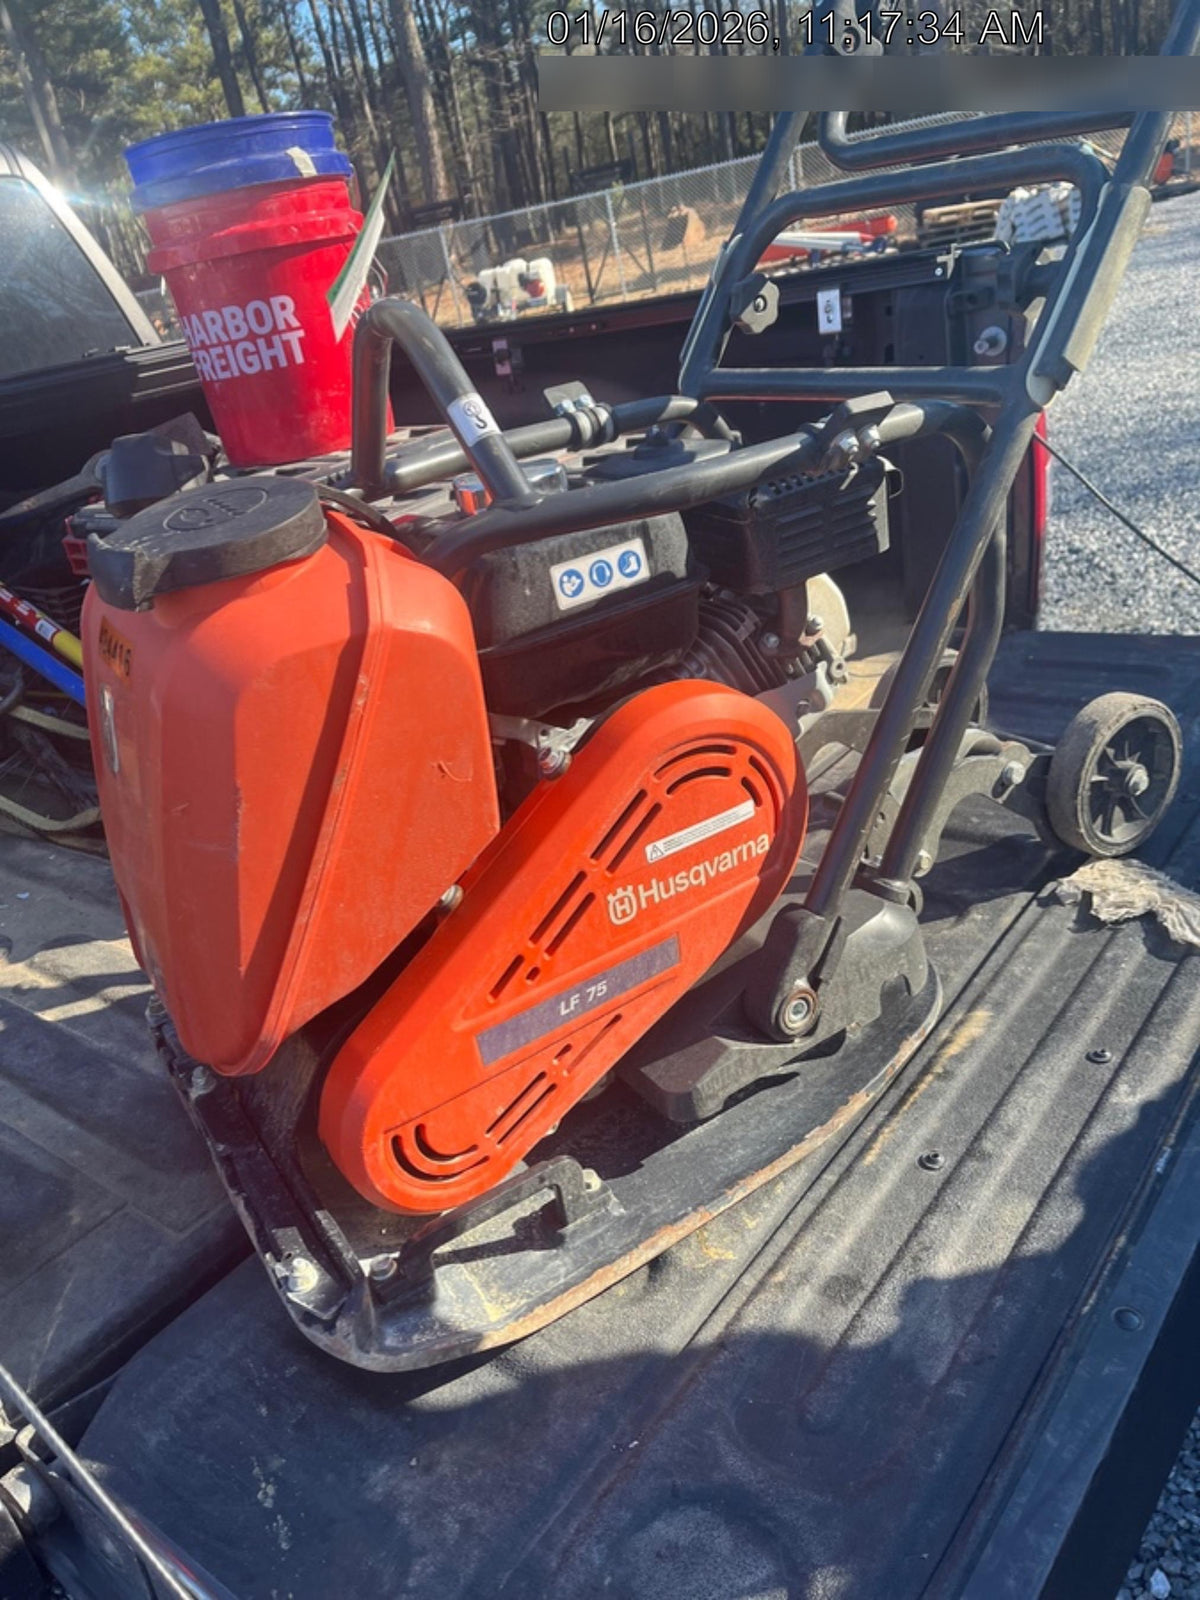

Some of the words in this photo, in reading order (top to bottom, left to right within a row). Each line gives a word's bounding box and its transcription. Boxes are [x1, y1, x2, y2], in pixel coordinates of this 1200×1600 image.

[182, 295, 300, 348] HARBOR
[193, 330, 305, 382] FREIGHT
[637, 833, 770, 909] Husqvarna
[559, 993, 580, 1016] LF
[586, 980, 608, 1004] 75
